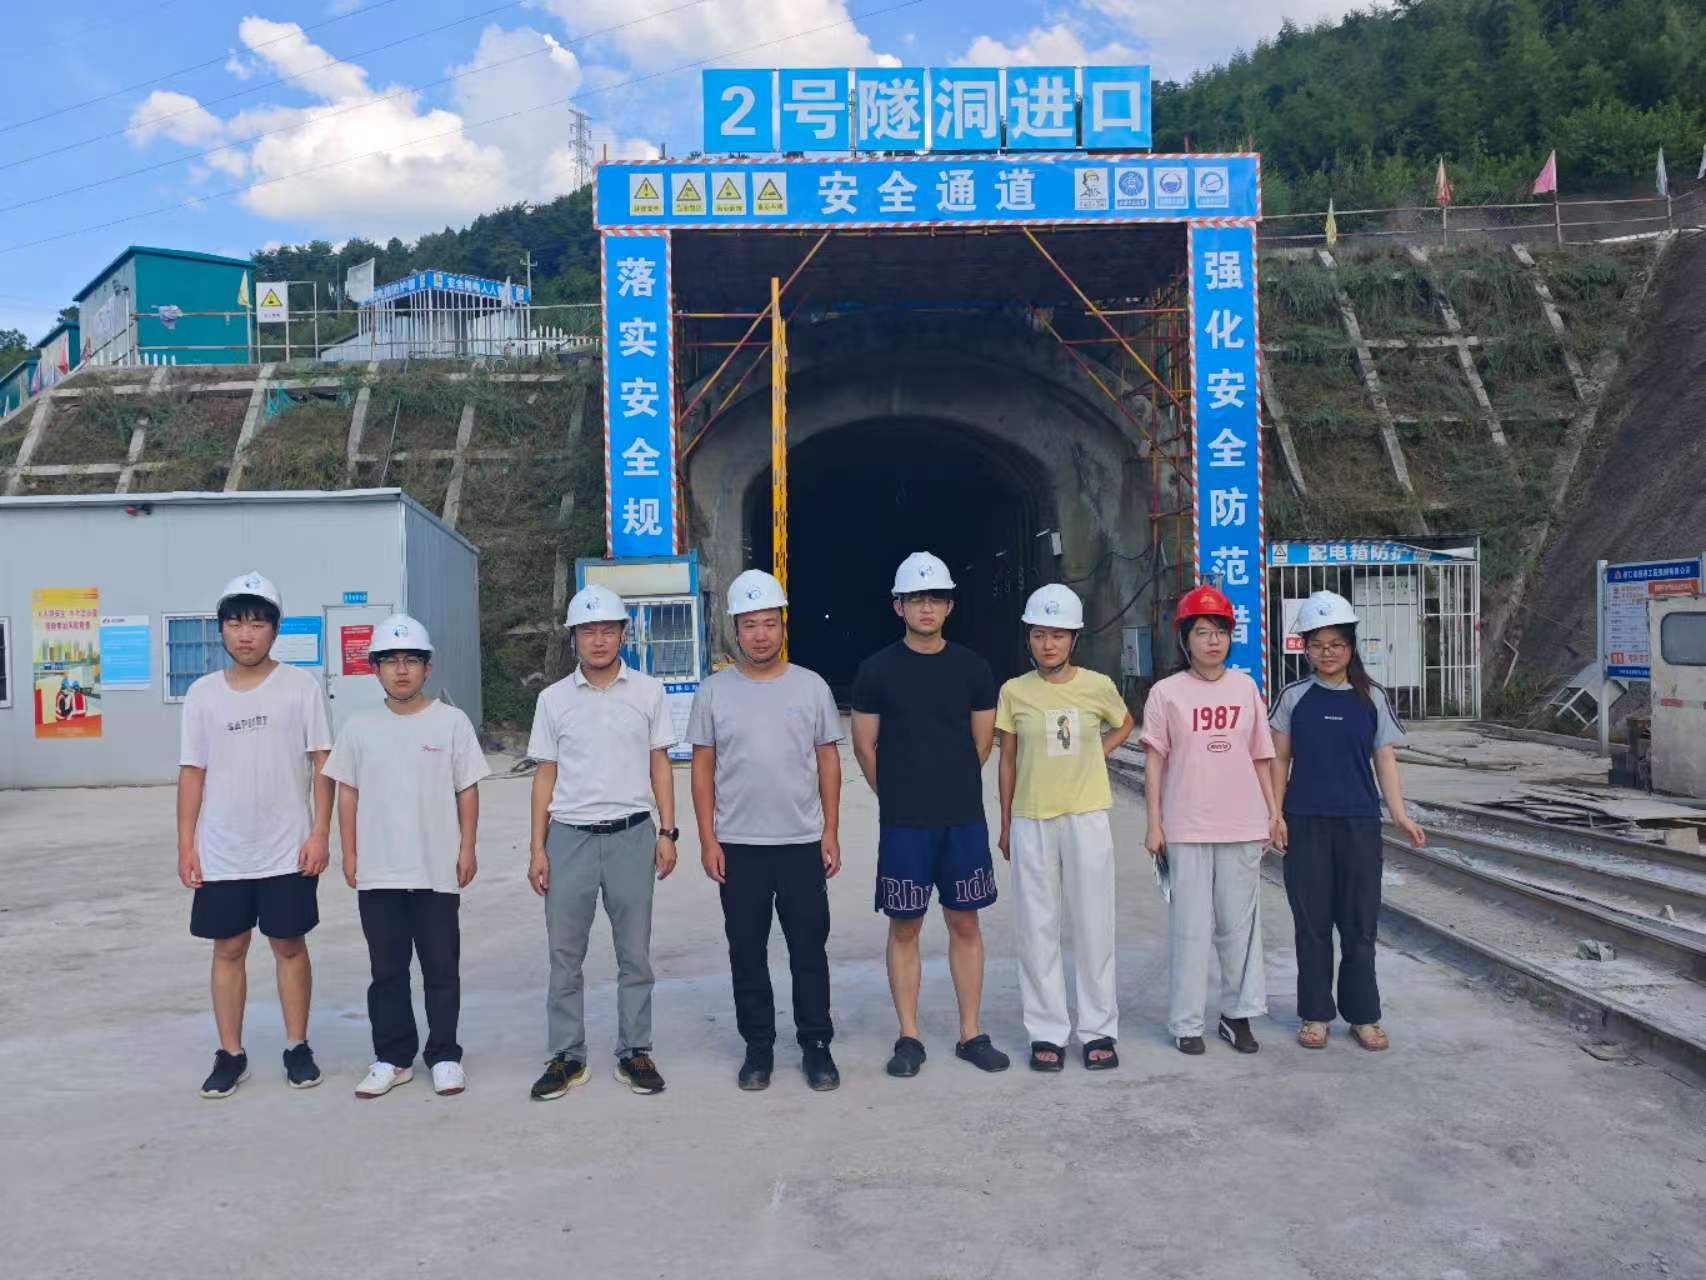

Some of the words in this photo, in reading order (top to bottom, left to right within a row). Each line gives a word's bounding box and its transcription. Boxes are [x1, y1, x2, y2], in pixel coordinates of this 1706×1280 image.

[720, 78, 1142, 141] 2号隧洞进口
[819, 170, 1036, 214] 安全通道
[617, 257, 663, 537] 落实安全规
[1193, 705, 1240, 731] 1987
